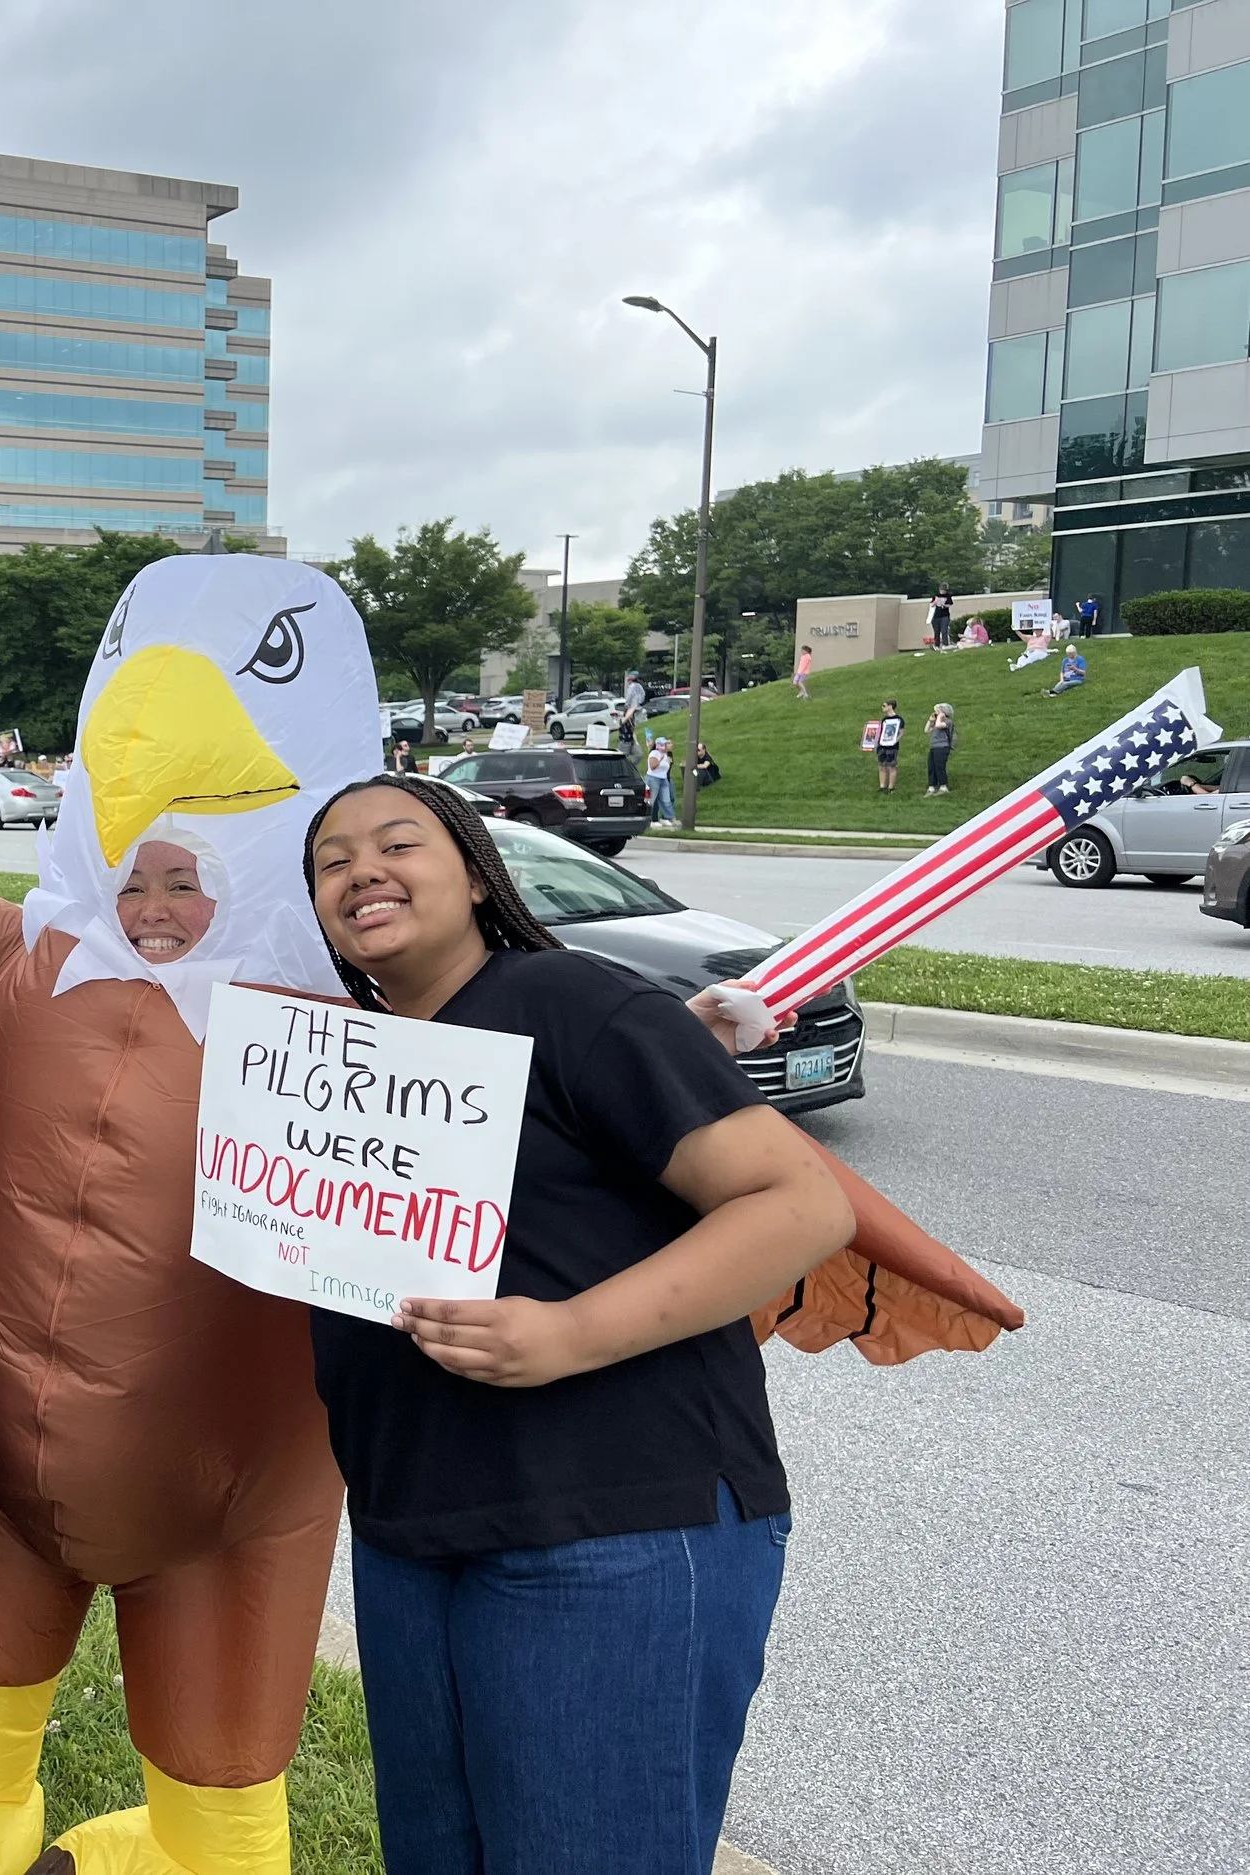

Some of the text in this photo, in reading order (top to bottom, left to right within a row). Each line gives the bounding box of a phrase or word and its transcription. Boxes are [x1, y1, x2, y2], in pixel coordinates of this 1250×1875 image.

[281, 1005, 377, 1070] THE
[241, 1043, 489, 1126] PILGRIMS
[286, 1121, 420, 1180] WERE
[278, 1241, 310, 1265] NOT
[309, 1269, 396, 1314] IMMIGR
